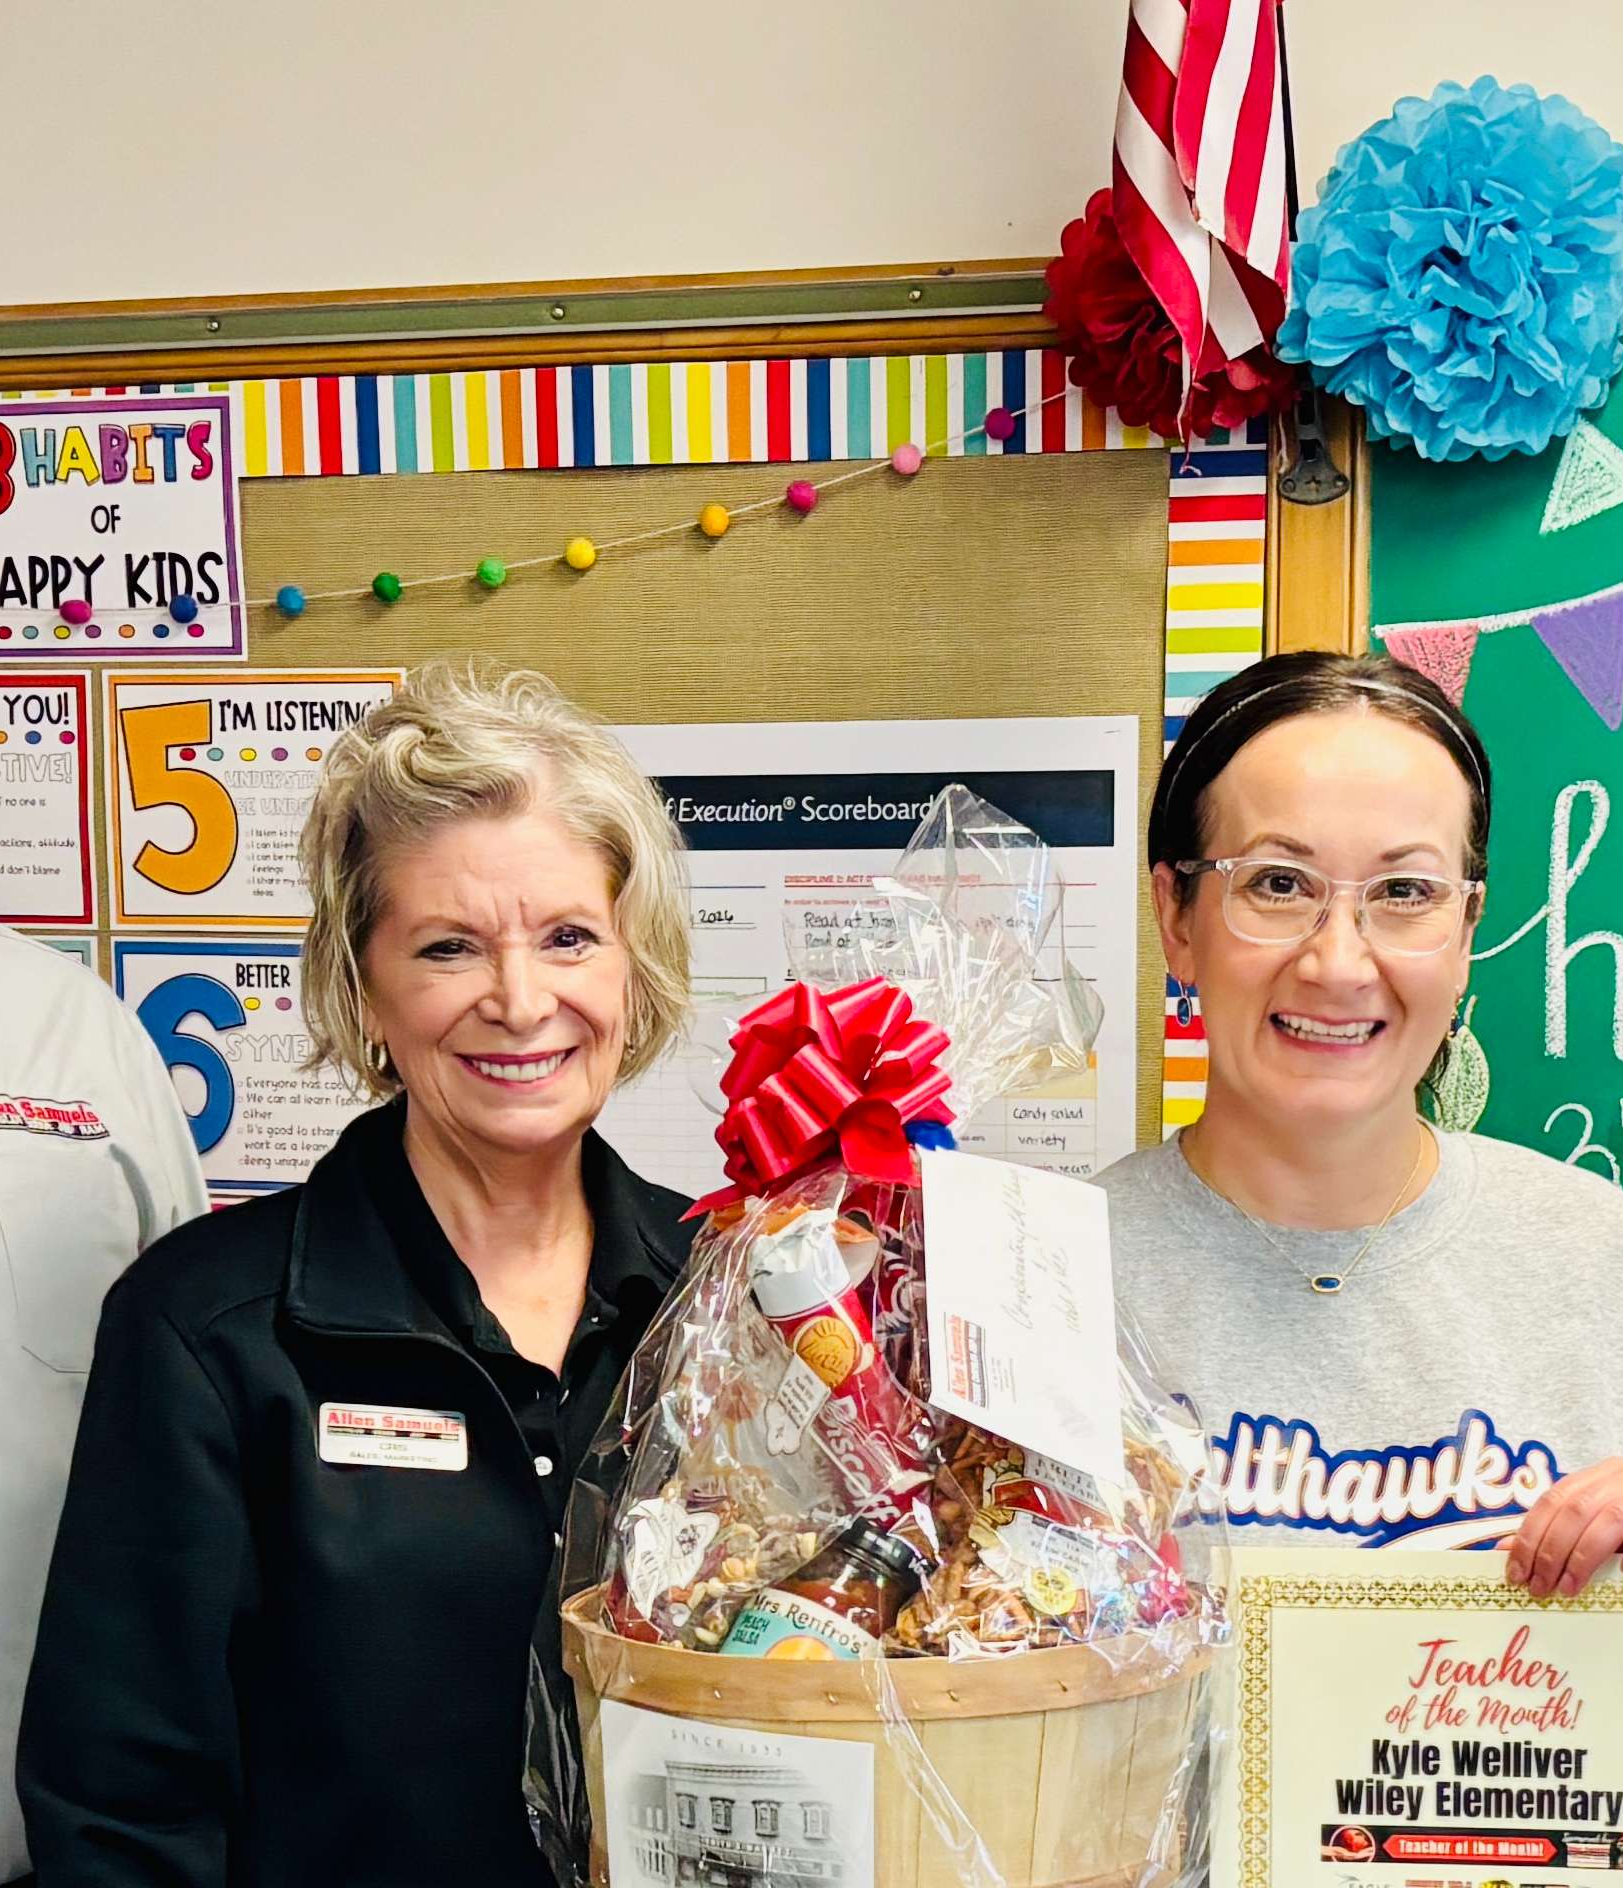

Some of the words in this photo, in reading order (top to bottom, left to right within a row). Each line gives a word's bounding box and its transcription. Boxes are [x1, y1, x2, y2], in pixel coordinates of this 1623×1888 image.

[19, 420, 213, 487] HABITS
[91, 504, 121, 534] OF
[125, 552, 223, 609] KIDS
[3, 692, 69, 725] YOU!
[219, 700, 256, 732] I'M
[120, 699, 248, 895] 5
[801, 794, 935, 821] Scoreboard
[236, 963, 291, 989] BETTER
[226, 1032, 311, 1063] SYNE
[136, 973, 246, 1155] 6
[246, 1077, 298, 1091] Everyone
[20, 1101, 99, 1123] Samuels
[267, 1124, 293, 1138] good
[328, 1411, 375, 1426] Allen
[382, 1416, 460, 1432] Samuels
[1408, 1624, 1569, 1691] Teacher
[1386, 1694, 1417, 1734] of
[1422, 1685, 1469, 1731] the
[1478, 1687, 1584, 1735] Month!
[1372, 1739, 1440, 1780] Kyle
[1452, 1740, 1588, 1780] Welliver
[1336, 1779, 1424, 1821] Wiley
[1435, 1781, 1623, 1826] Elementary
[1399, 1838, 1451, 1855] Teacher
[1455, 1840, 1469, 1855] of
[1472, 1840, 1494, 1856] the
[1498, 1841, 1545, 1857] Month!
